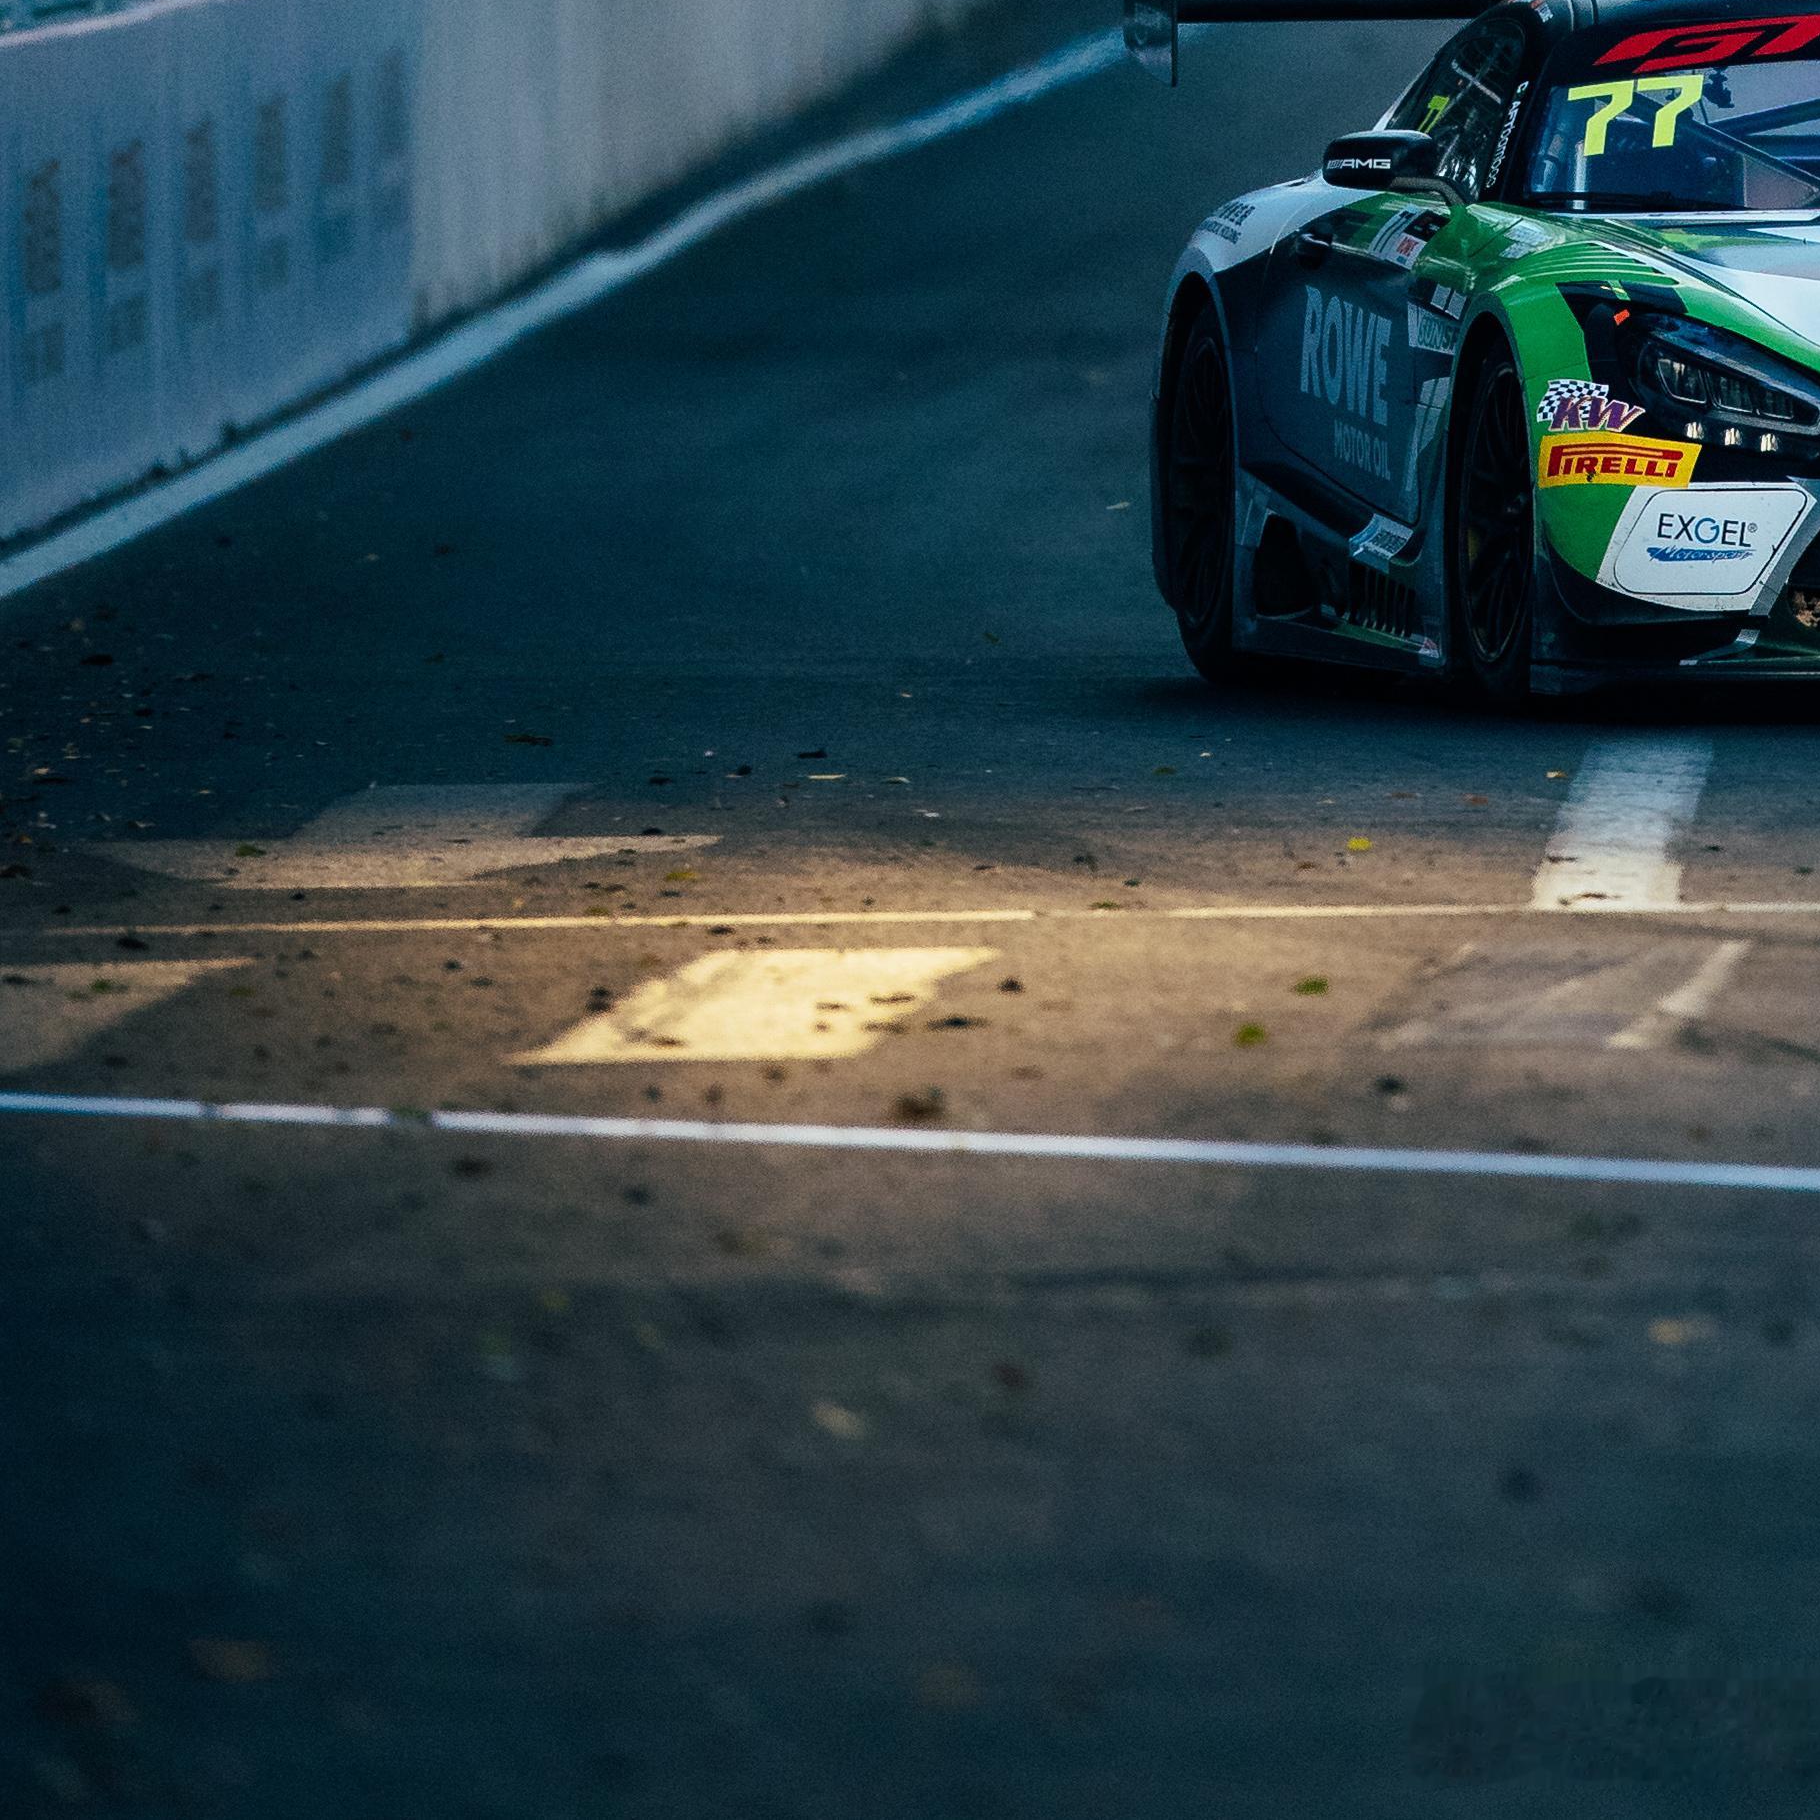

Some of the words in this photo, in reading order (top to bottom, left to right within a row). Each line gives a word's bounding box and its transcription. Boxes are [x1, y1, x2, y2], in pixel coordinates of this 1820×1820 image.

[1568, 75, 1703, 156] 77
[1339, 158, 1392, 170] AMG
[1300, 284, 1393, 427] ROWE
[1548, 394, 1646, 433] KW
[1333, 418, 1373, 474] MOTOR
[1373, 436, 1391, 481] OIL
[1547, 442, 1684, 479] PIRELLI
[1648, 544, 1754, 564] Motorsport
